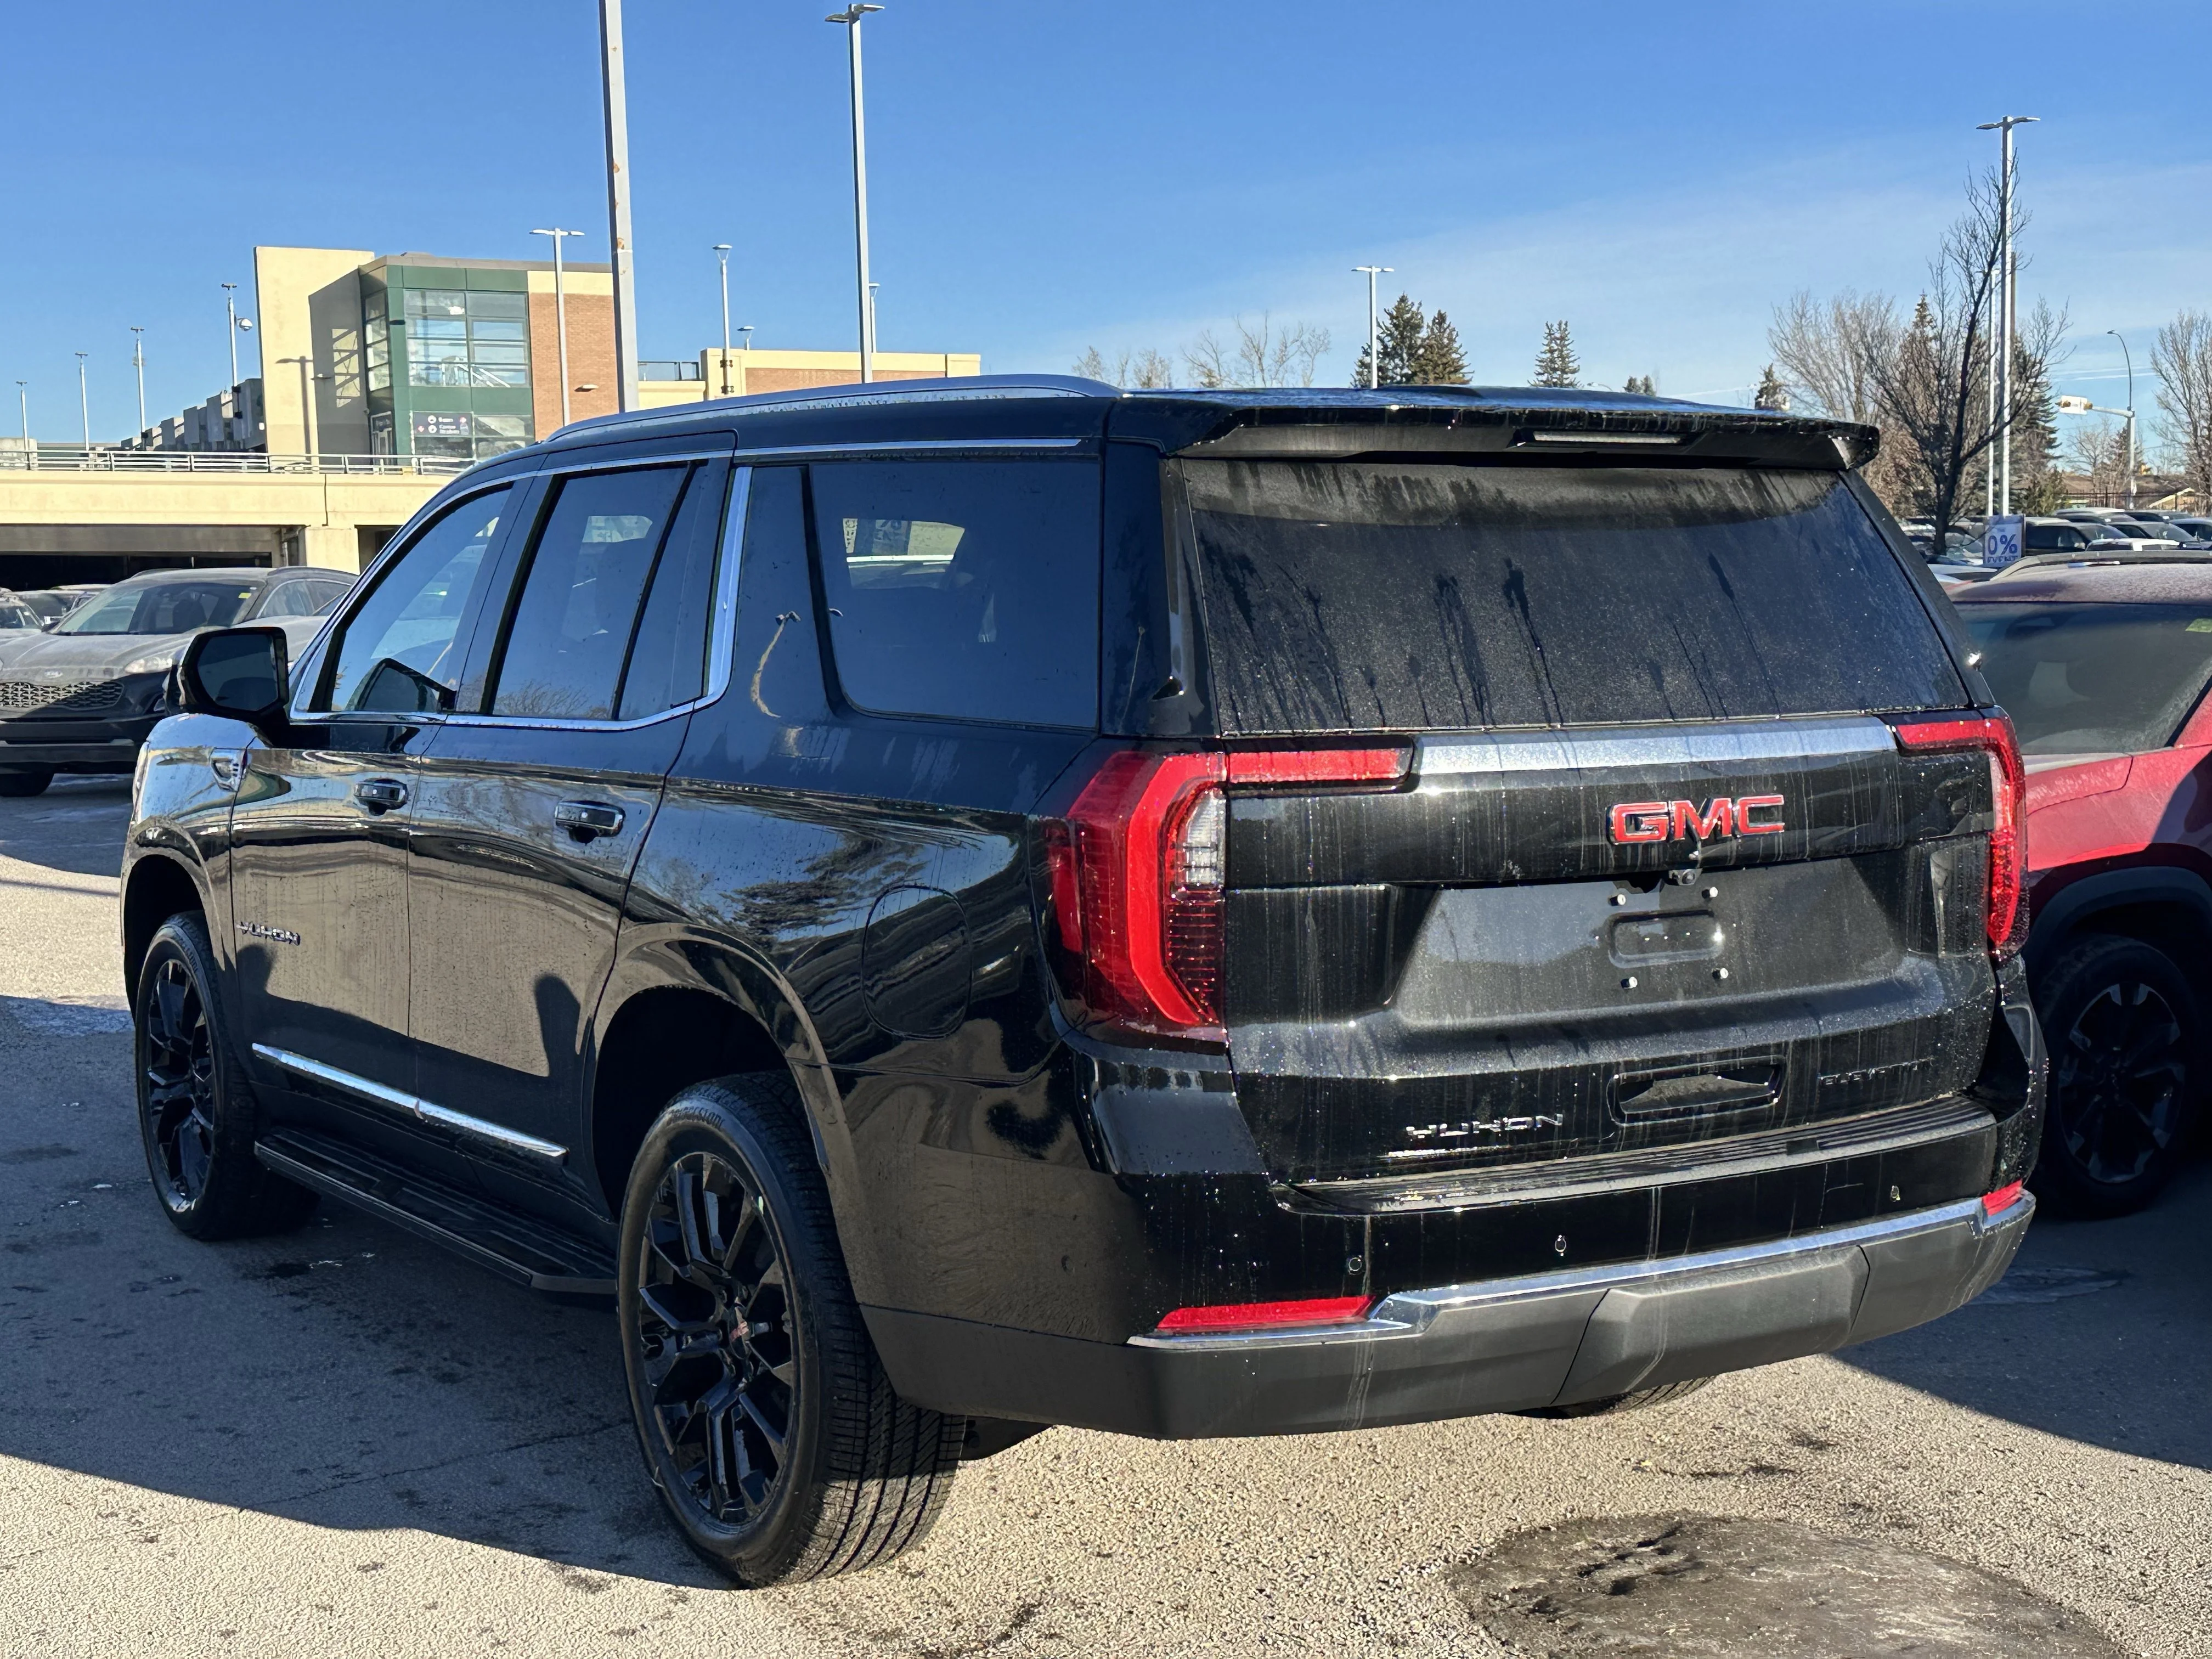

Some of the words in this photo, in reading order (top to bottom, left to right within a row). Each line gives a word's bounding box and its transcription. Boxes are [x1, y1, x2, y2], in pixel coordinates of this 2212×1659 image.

[1988, 534, 2018, 555] 0%
[1607, 794, 1785, 845] GMC
[235, 921, 301, 946] YUKON
